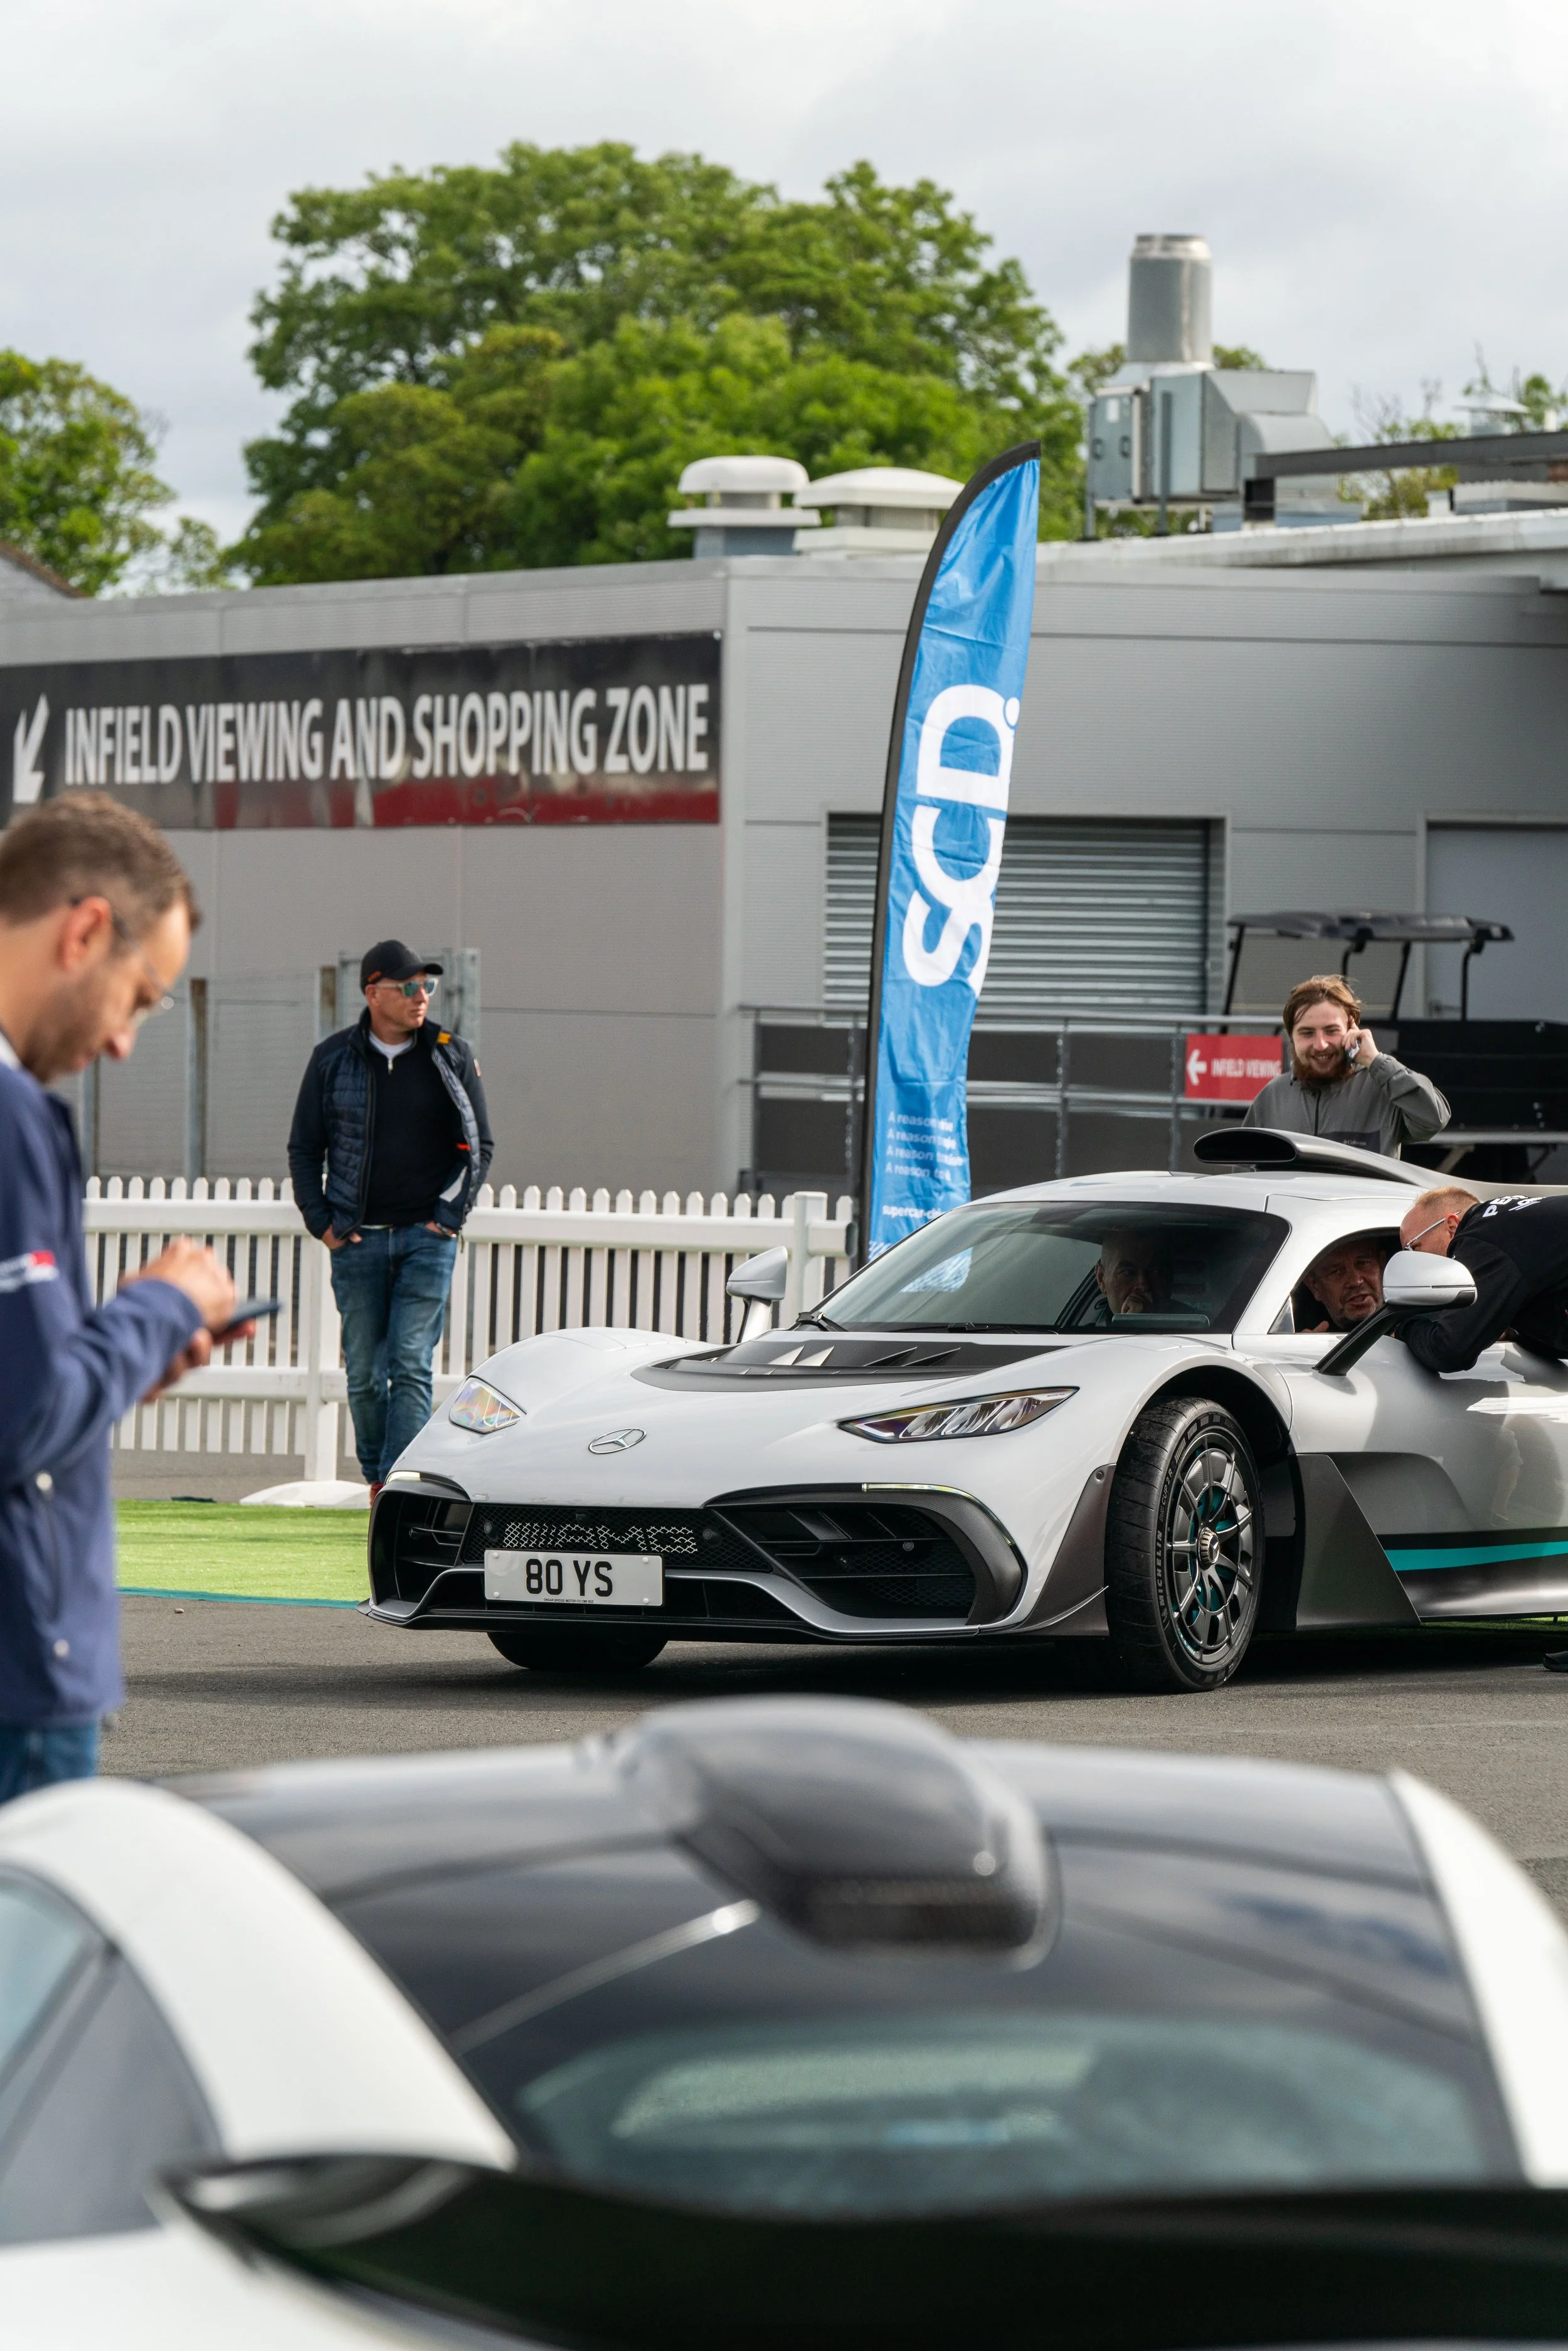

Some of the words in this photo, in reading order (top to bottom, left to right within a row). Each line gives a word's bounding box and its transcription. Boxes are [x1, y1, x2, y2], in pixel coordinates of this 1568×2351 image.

[65, 703, 183, 785] INFIELD
[186, 698, 323, 783] VIEWING
[331, 696, 406, 780] AND
[411, 689, 596, 779] SHOPPING
[605, 683, 709, 774] ZONE
[1211, 1058, 1244, 1078] INFIELD
[887, 1110, 896, 1123] A
[887, 1127, 894, 1140] A
[886, 1144, 894, 1156] A
[895, 1147, 934, 1161] reason
[884, 1161, 893, 1174] A
[894, 1164, 930, 1178] reason
[1168, 1468, 1173, 1477] R
[1156, 1530, 1165, 1606] MICHELIN
[526, 1558, 563, 1595] 80
[573, 1560, 613, 1597] YS
